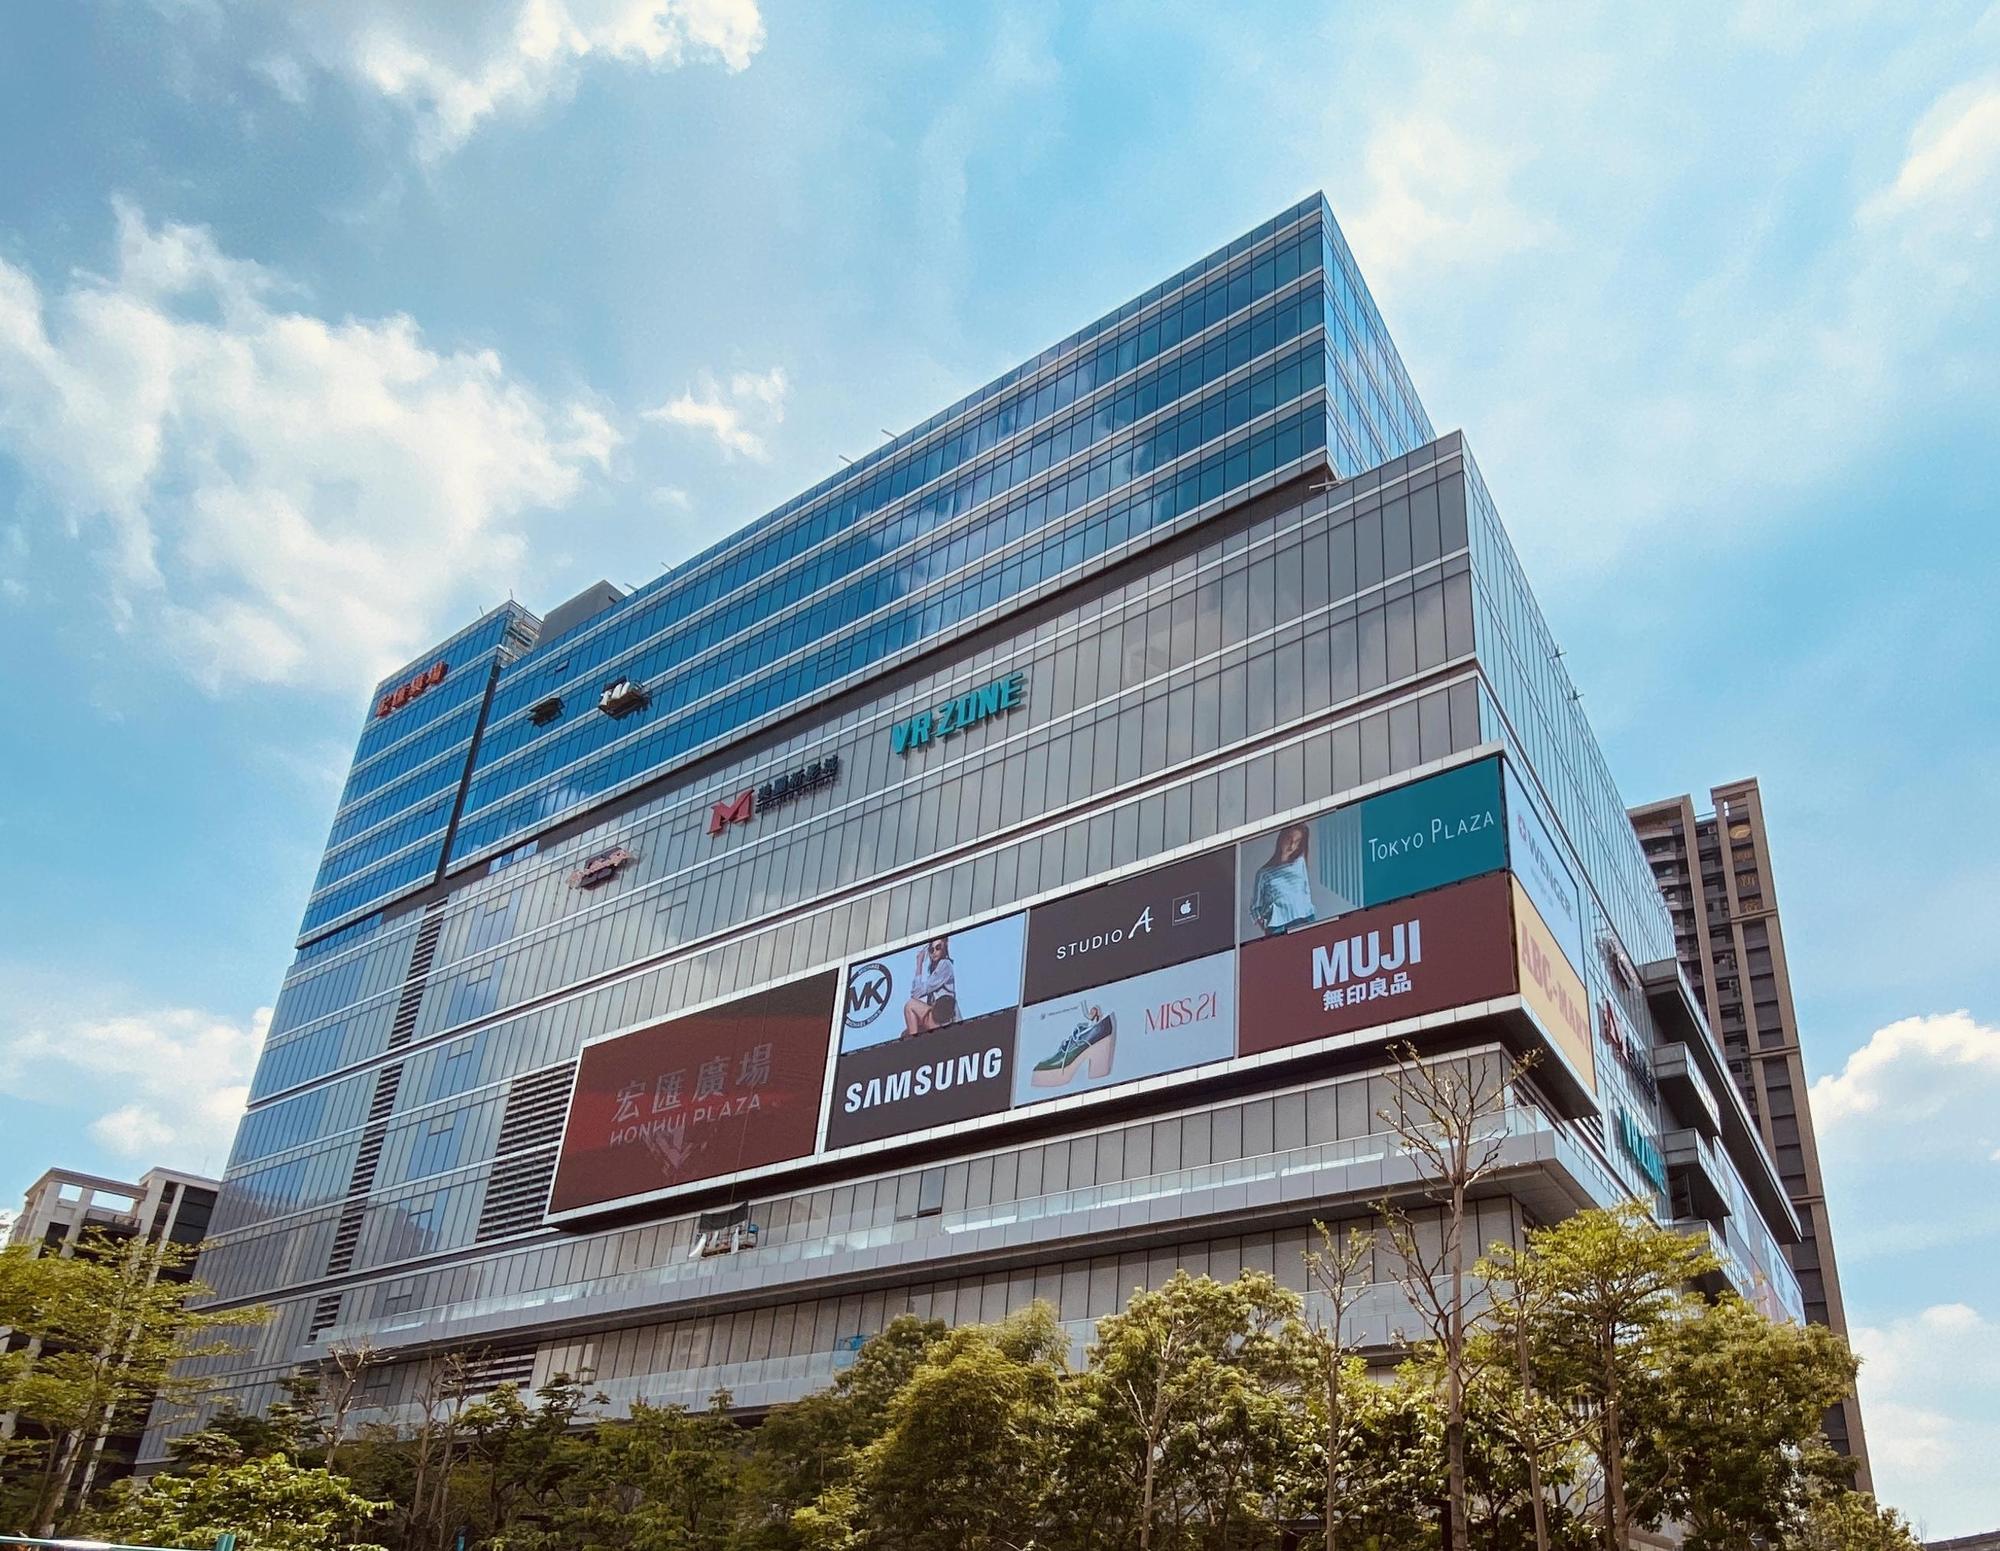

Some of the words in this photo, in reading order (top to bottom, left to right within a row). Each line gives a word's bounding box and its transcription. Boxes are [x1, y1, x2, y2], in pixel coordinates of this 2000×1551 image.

[891, 709, 932, 755] VR
[935, 672, 1024, 738] ZONE
[1056, 929, 1123, 960] STUDIO
[1127, 906, 1154, 940] A
[1312, 919, 1422, 990] MUJI
[847, 976, 887, 1014] MK
[1144, 997, 1193, 1035] MISS
[1196, 991, 1217, 1022] 21
[1322, 971, 1412, 1012] 無印良品
[1521, 920, 1591, 1054] ABC-MART
[611, 1043, 773, 1122] 宏匯廣場
[844, 1047, 1003, 1113] SAMSUNG
[609, 1112, 687, 1147] HONHUI
[692, 1093, 761, 1126] PLAZA
